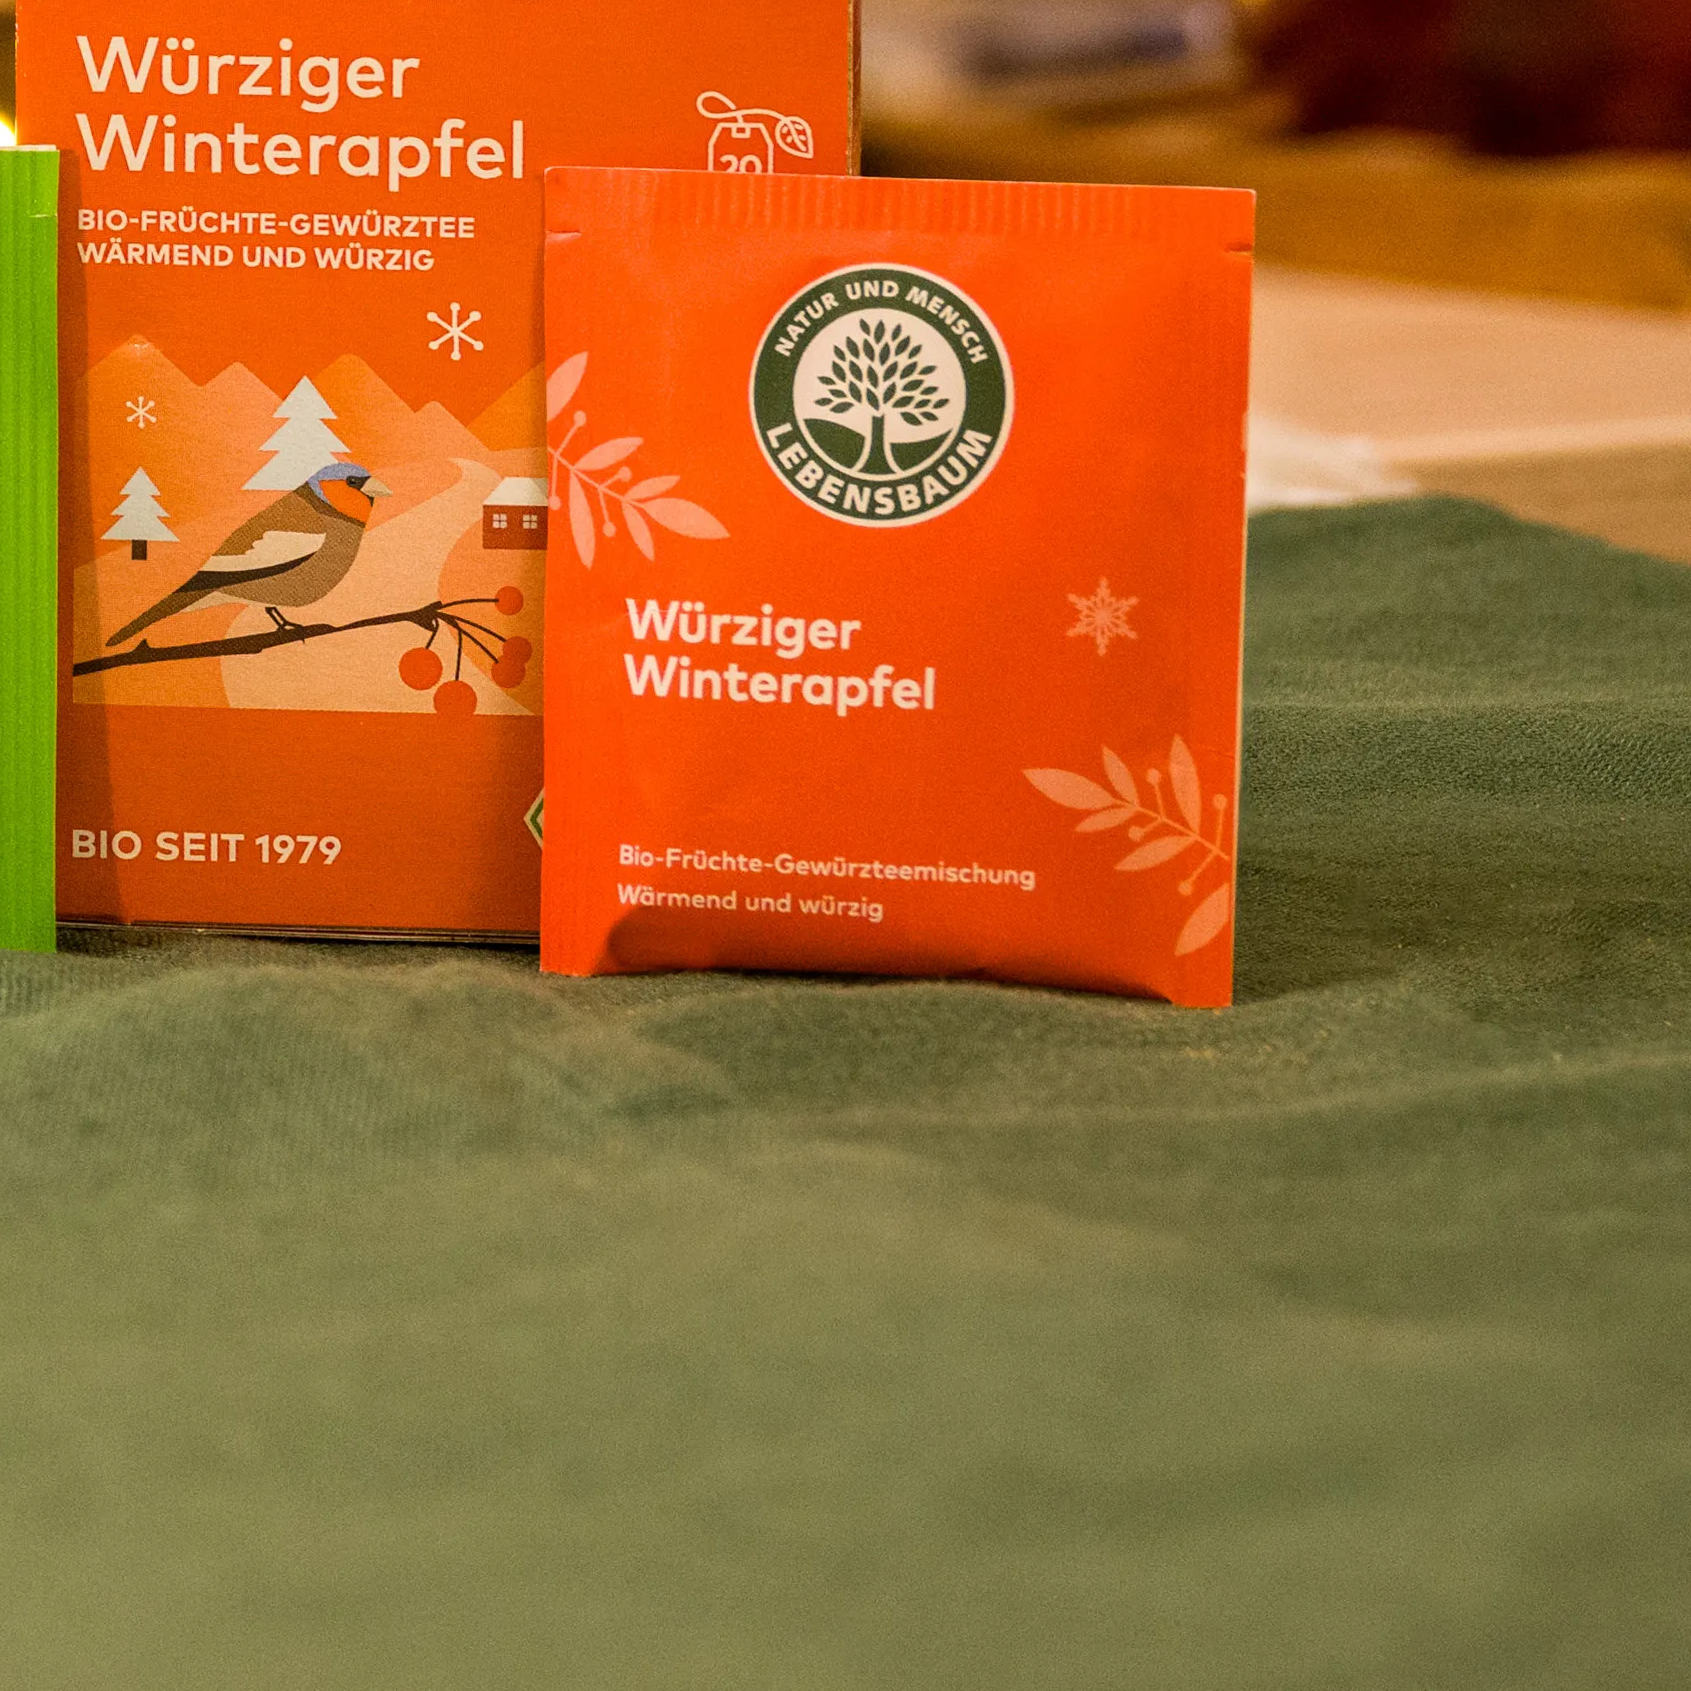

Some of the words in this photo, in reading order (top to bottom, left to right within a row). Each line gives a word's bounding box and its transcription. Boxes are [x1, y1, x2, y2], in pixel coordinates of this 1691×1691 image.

[76, 35, 420, 113] Würziger
[75, 113, 524, 193] Winterapfel
[78, 205, 475, 239] BIO-FRÜCHTE-GEWÜRZTEE
[77, 237, 234, 267] WÄRMEND
[242, 245, 306, 269] UND
[314, 242, 435, 271] WÜRZIG
[774, 292, 839, 357] NATUR
[845, 280, 900, 300] UND
[905, 286, 988, 363] MENSCH
[766, 422, 992, 516] LEBENSBAUM
[625, 598, 862, 660] Würziger
[623, 653, 936, 717] Winterapfel
[72, 829, 142, 860] BIO
[156, 831, 245, 862] SEIT
[255, 834, 342, 865] 1979
[618, 842, 1036, 891] Bio-Früchte-Gewürzteemischung
[616, 882, 737, 910] Wärmend
[745, 892, 792, 913] und
[798, 895, 884, 924] würzig
